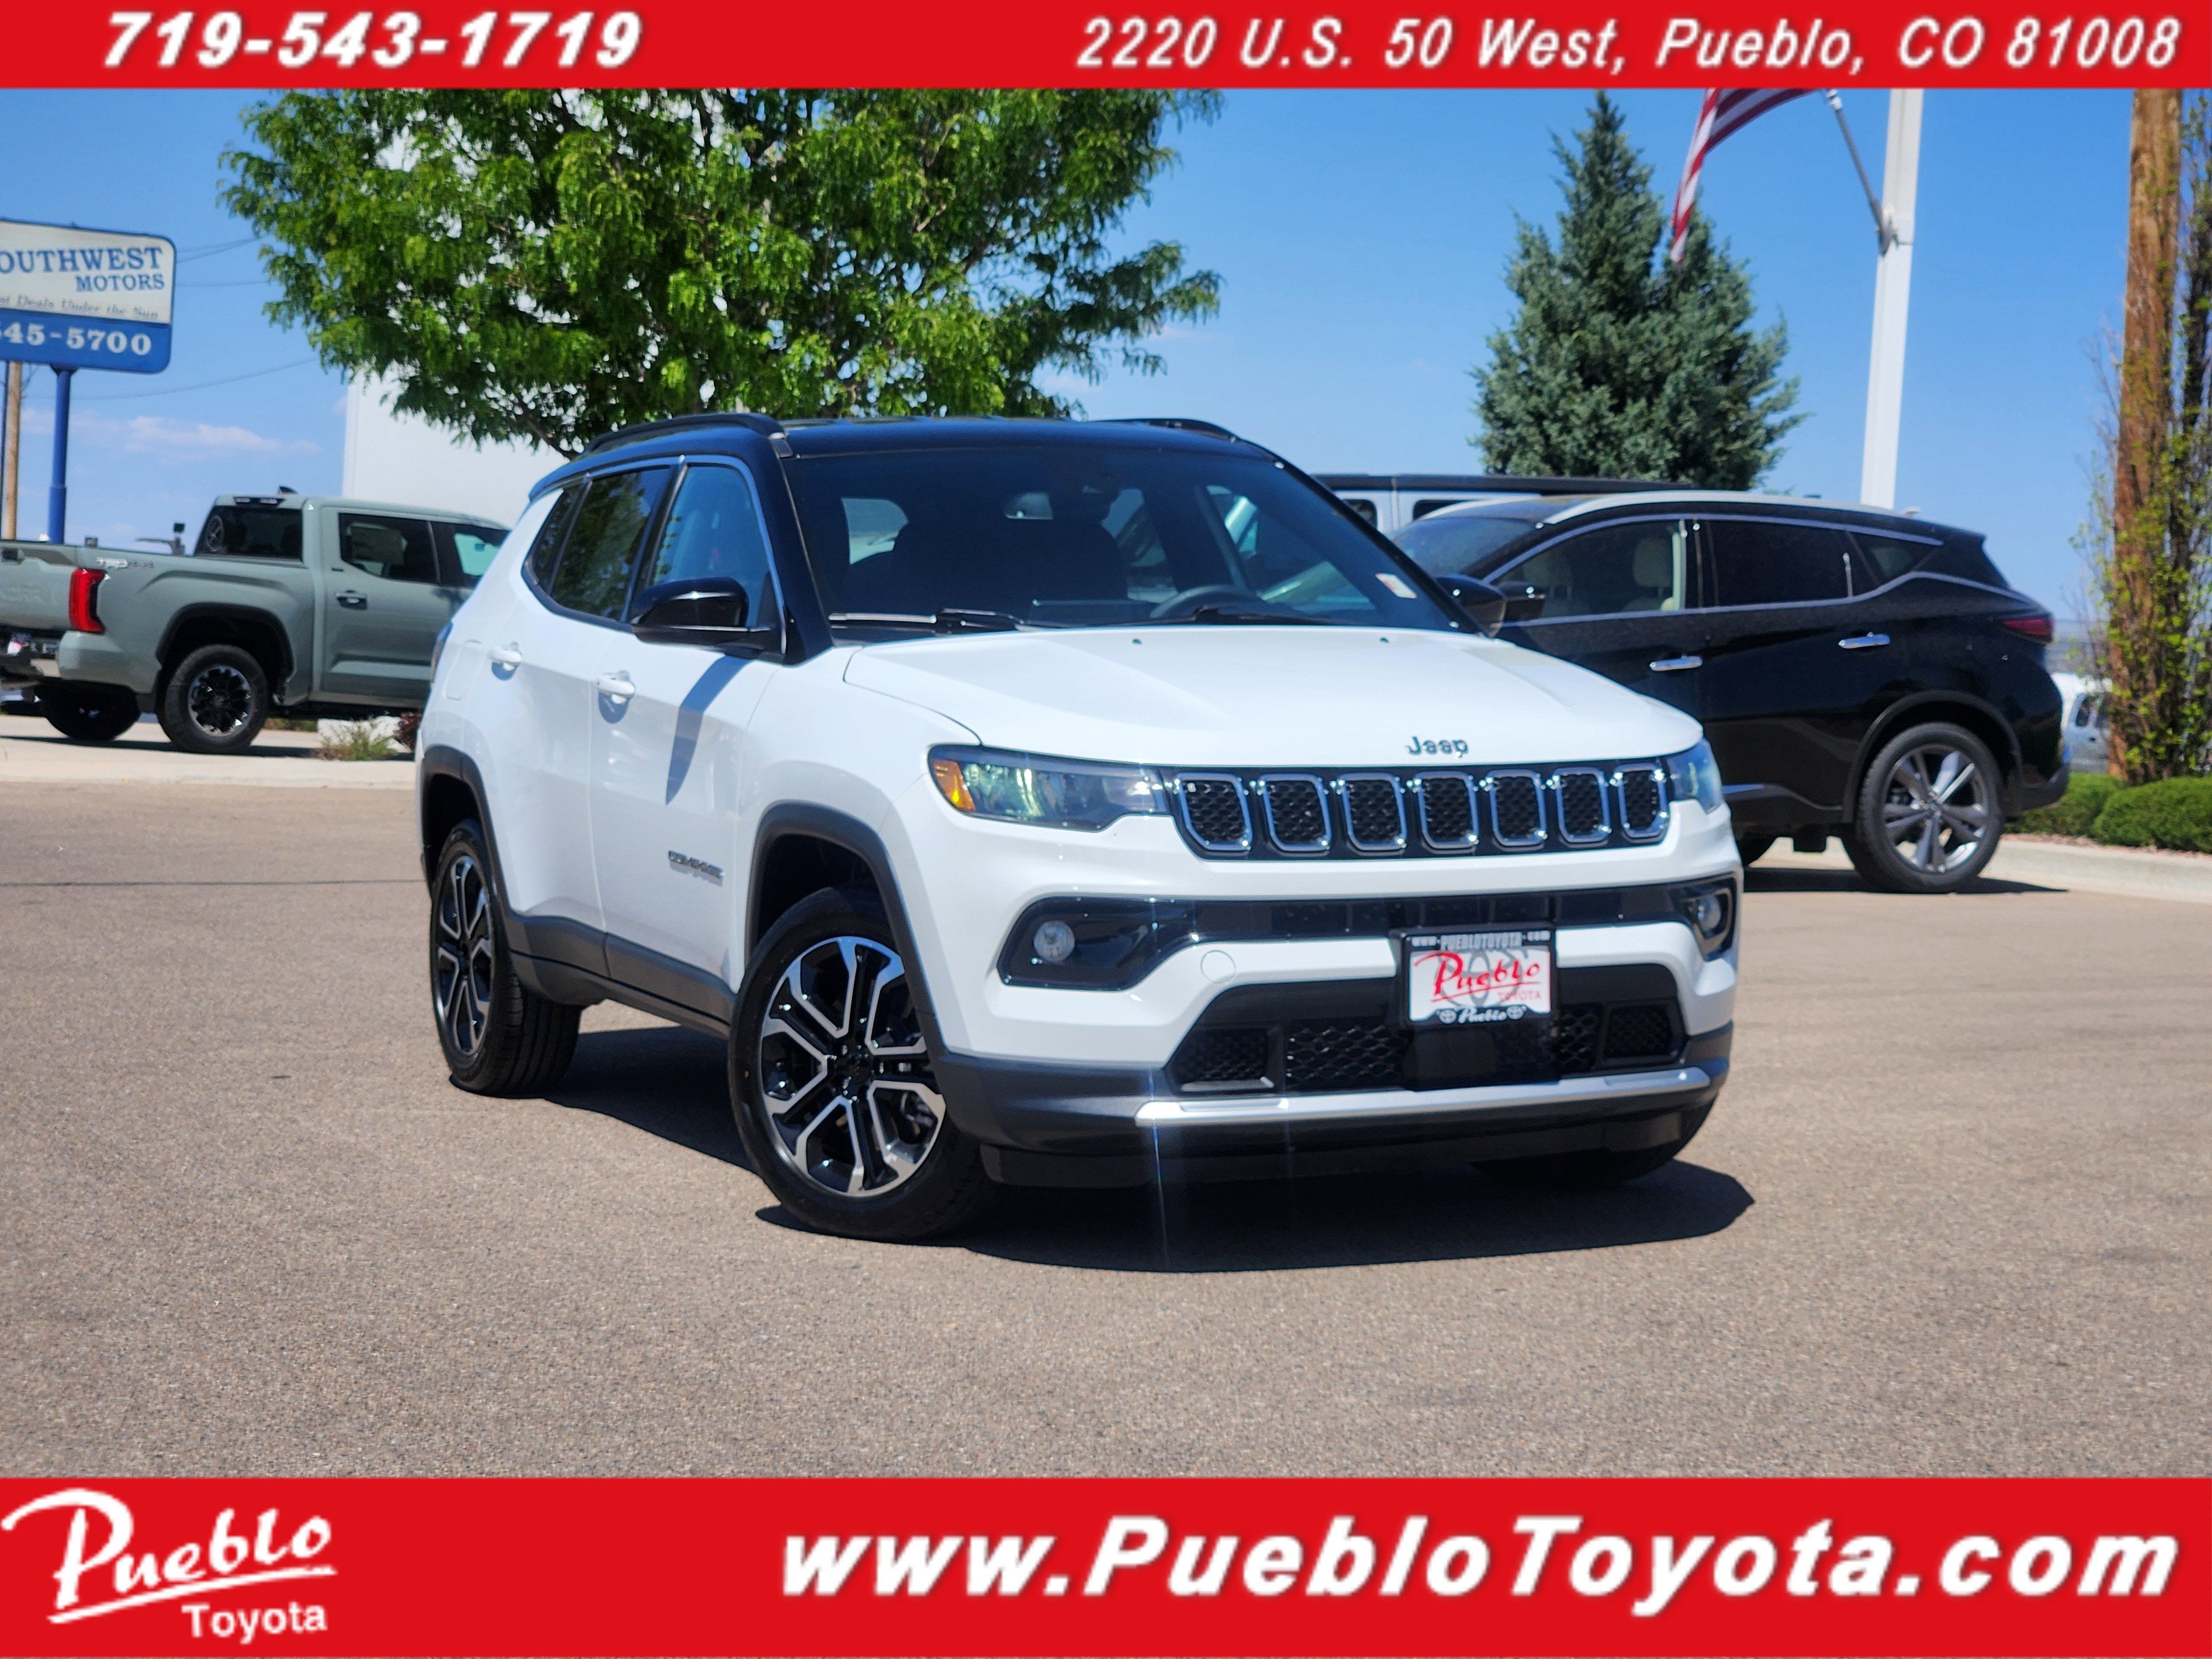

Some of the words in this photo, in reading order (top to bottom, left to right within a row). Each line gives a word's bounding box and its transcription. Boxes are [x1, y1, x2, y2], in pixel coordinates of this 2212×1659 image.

[75, 274, 164, 293] MOTORS
[61, 298, 101, 314] Under
[107, 303, 127, 315] the
[133, 305, 159, 319] Sun
[0, 322, 152, 356] 45-5700
[1405, 735, 1469, 758] Jeep
[1414, 952, 1540, 995] Pueblo
[1499, 990, 1541, 1001] TOYOTA
[1458, 1007, 1507, 1024] Pueblo
